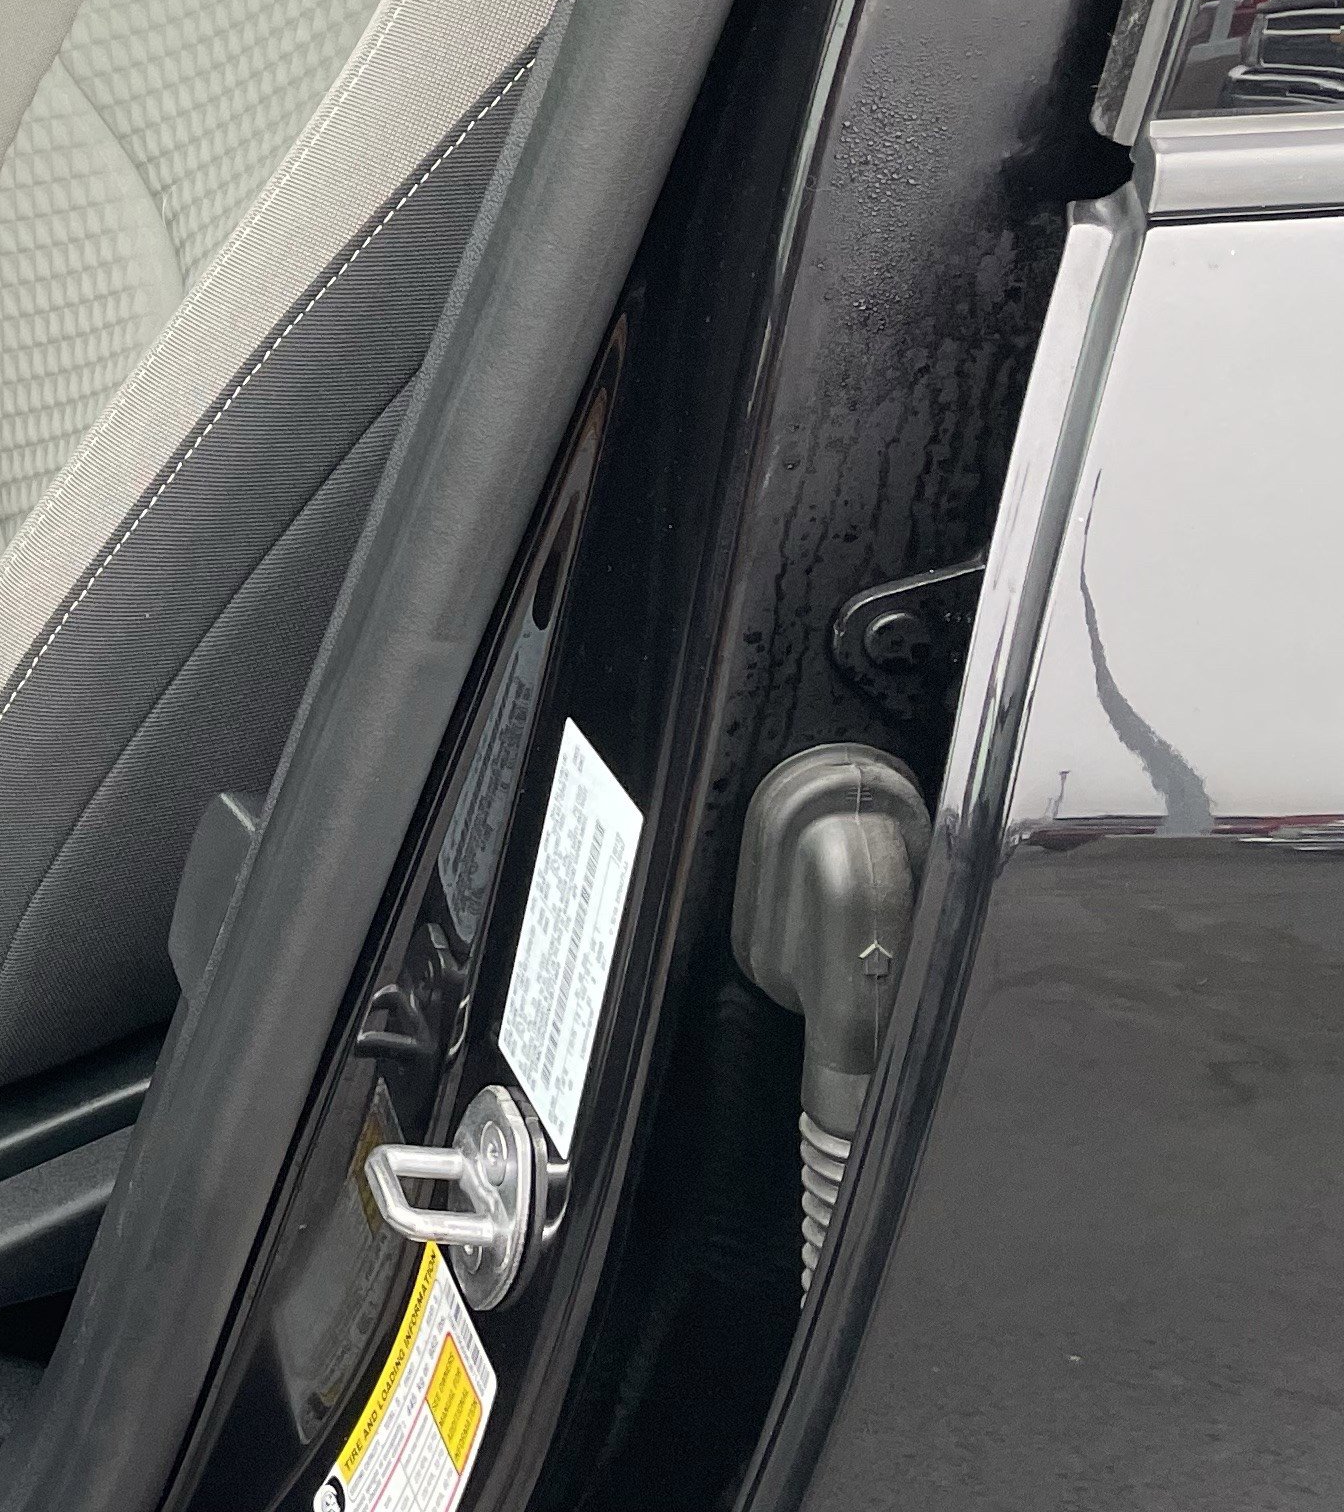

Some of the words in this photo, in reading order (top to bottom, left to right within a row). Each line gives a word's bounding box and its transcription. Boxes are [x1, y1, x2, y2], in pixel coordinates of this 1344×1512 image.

[344, 1438, 363, 1472] TIRE
[363, 1410, 378, 1440] AND
[377, 1349, 406, 1411] LOADING
[403, 1251, 438, 1350] INFORMATION
